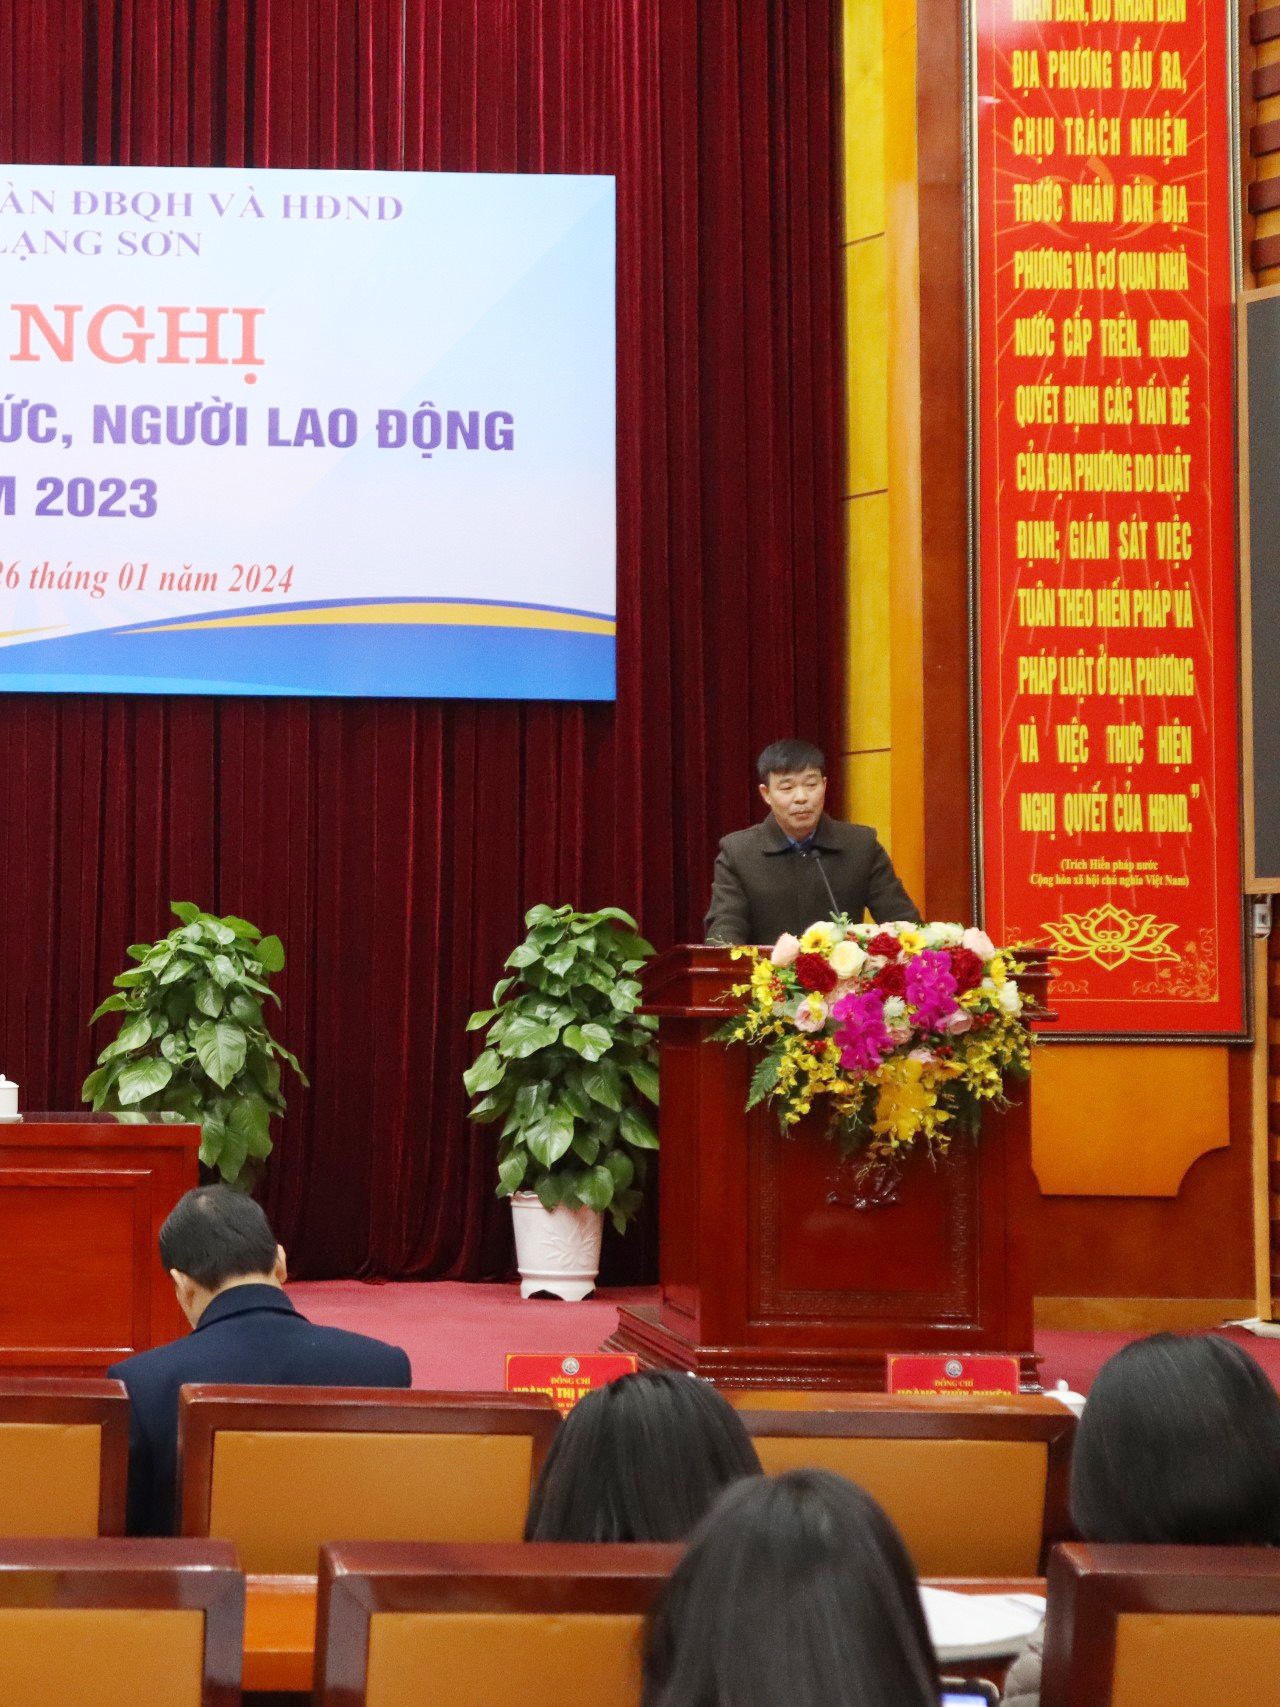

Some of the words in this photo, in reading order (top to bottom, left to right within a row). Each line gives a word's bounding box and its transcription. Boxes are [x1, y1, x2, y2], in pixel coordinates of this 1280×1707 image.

[1011, 49, 1041, 97] ĐỊA
[1047, 46, 1112, 90] PHƯƠNG
[1159, 50, 1187, 94] RA,
[1011, 116, 1055, 164] CHỊU
[1063, 109, 1121, 156] TRÁCH
[1130, 109, 1188, 165] NHIỆM
[73, 191, 192, 223] ĐBQH
[209, 185, 265, 218] VÀ
[283, 194, 403, 221] HĐND
[1013, 175, 1063, 223] TRƯỚC
[1071, 176, 1114, 223] NHÂN
[1122, 176, 1154, 224] DÂN
[1159, 184, 1189, 232] ĐỊA
[117, 230, 200, 257] SƠN
[1013, 247, 1073, 290] PHƯƠNG
[1074, 243, 1094, 290] VÀ
[1095, 247, 1116, 290] CƠ
[1118, 251, 1157, 294] QUAN
[1157, 244, 1189, 291] NHÀ
[9, 303, 266, 385] NGHỊ
[1013, 309, 1055, 357] NƯỚC
[1062, 304, 1093, 358] CẤP
[1149, 319, 1190, 358] HĐND
[92, 395, 248, 447] NGƯỜI
[267, 407, 358, 449] LAO
[375, 400, 514, 459] ĐỘNG
[1015, 373, 1061, 428] QUYẾT
[1063, 385, 1099, 433] ĐỊNH
[1103, 377, 1133, 425] CÁC
[1137, 372, 1167, 425] VẤN
[34, 476, 158, 519] 2023
[1016, 439, 1046, 492] CỦA
[1047, 452, 1073, 500] ĐỊA
[1074, 449, 1133, 492] PHƯƠNG
[1134, 453, 1155, 493] DO
[1155, 445, 1192, 502] LUẬT
[1016, 520, 1061, 568] ĐỊNH;
[1068, 512, 1110, 560] GIÁM
[1118, 513, 1149, 560] SÁT
[1155, 513, 1192, 569] VIỆC
[29, 561, 109, 599] tháng
[118, 562, 149, 591] 01
[158, 564, 218, 592] năm
[227, 563, 294, 594] 2024
[1017, 580, 1056, 628] TUÂN
[1057, 588, 1094, 628] THEO
[1096, 576, 1131, 628] HIẾN
[1132, 581, 1173, 628] PHÁP
[1172, 581, 1194, 628] VÀ
[1018, 647, 1058, 695] PHÁP
[1058, 648, 1095, 704] LUẬT
[1096, 643, 1108, 696] Ở
[1107, 656, 1135, 705] ĐỊA
[1135, 653, 1194, 697] PHƯƠNG
[1019, 715, 1040, 763] VÀ
[1056, 716, 1089, 773] VIỆC
[1105, 721, 1144, 773] THỰC
[1157, 717, 1193, 773] HIỆN
[1020, 792, 1056, 841] NGHỊ
[1063, 780, 1109, 837] QUYẾT
[1112, 780, 1144, 833] CỦA
